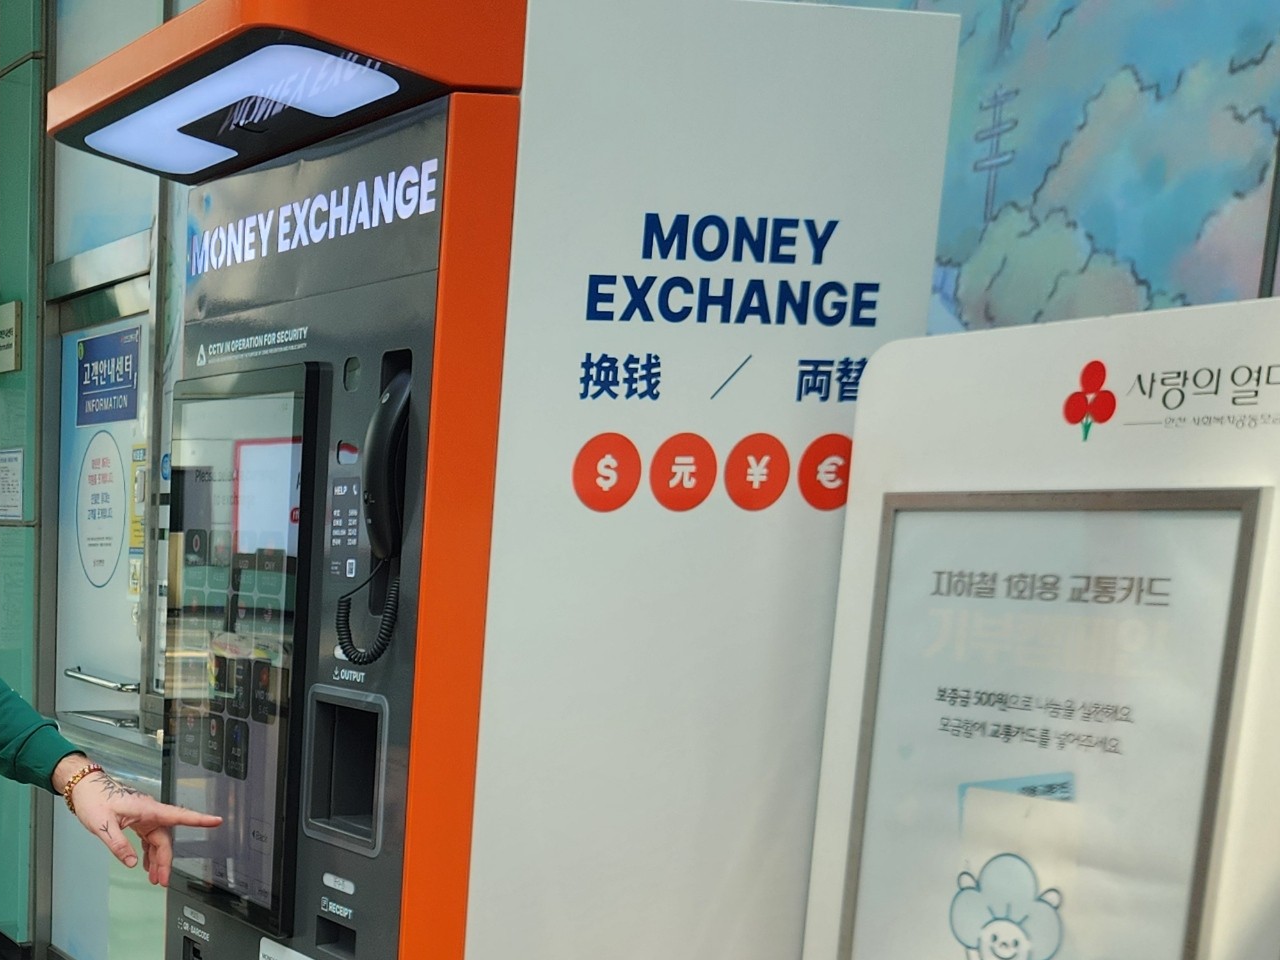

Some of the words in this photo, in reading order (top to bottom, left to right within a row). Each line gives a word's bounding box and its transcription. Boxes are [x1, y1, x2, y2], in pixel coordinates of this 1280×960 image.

[191, 209, 274, 276] MONEY
[277, 158, 439, 253] EXCHANGE
[641, 212, 840, 265] MONEY
[585, 274, 881, 327] EXCHANGE
[208, 342, 225, 355] CCTV
[231, 335, 264, 351] OPERATION
[263, 332, 277, 346] FOR
[276, 326, 309, 343] SECURITY
[82, 354, 132, 386] 고객안내센터
[579, 352, 662, 400] 换钱
[85, 395, 128, 413] INFORMATION
[1126, 367, 1222, 410] 사랑의
[595, 454, 619, 491] $
[669, 456, 698, 489] 元
[746, 454, 771, 489] ¥
[816, 456, 847, 489] €
[334, 485, 348, 496] HELP
[930, 571, 998, 599] 지하철
[1003, 572, 1061, 601] 1회용
[1065, 575, 1172, 606] 교통카드
[340, 668, 366, 683] OUTPUT
[935, 686, 971, 708] 보증금
[328, 901, 353, 919] RECEIPT
